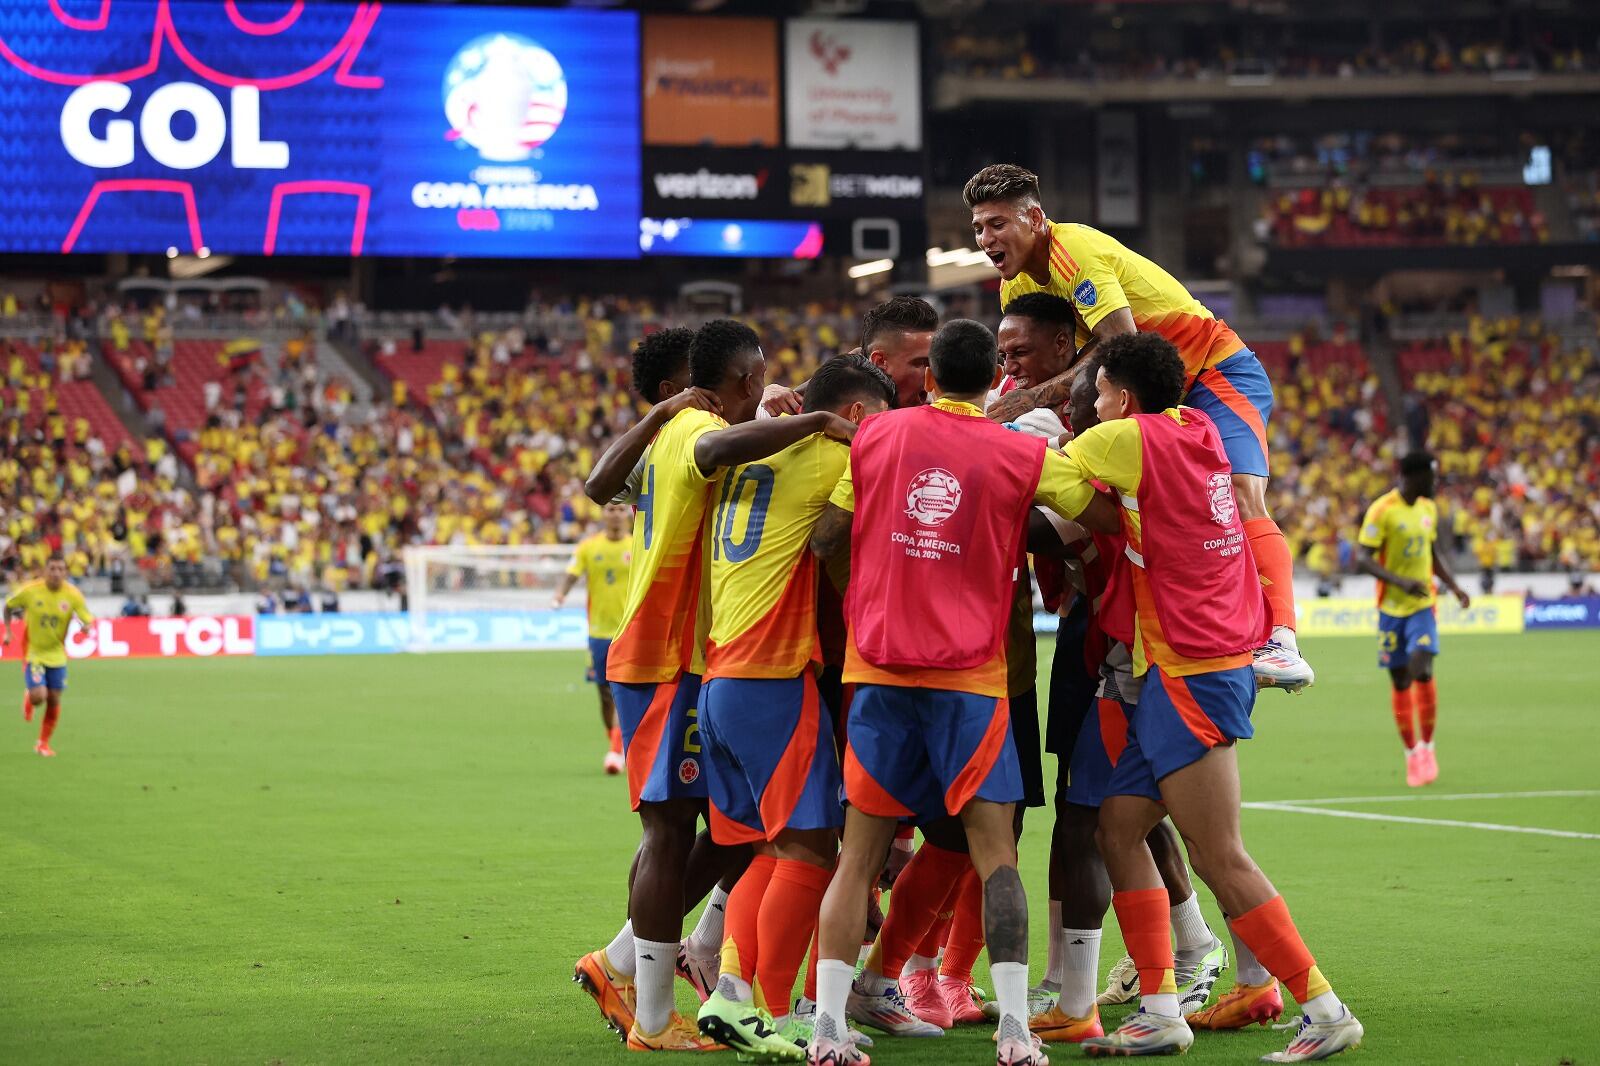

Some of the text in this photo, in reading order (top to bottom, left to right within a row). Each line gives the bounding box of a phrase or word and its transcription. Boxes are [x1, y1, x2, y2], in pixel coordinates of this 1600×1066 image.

[60, 81, 289, 169] GOL
[411, 182, 483, 208] COPA
[654, 168, 759, 199] verizon
[713, 464, 775, 563] 10
[891, 532, 961, 555] COPA AMERICA
[905, 547, 941, 561] USA 2024
[1203, 537, 1226, 550] COPA
[64, 615, 255, 658] CL TCL
